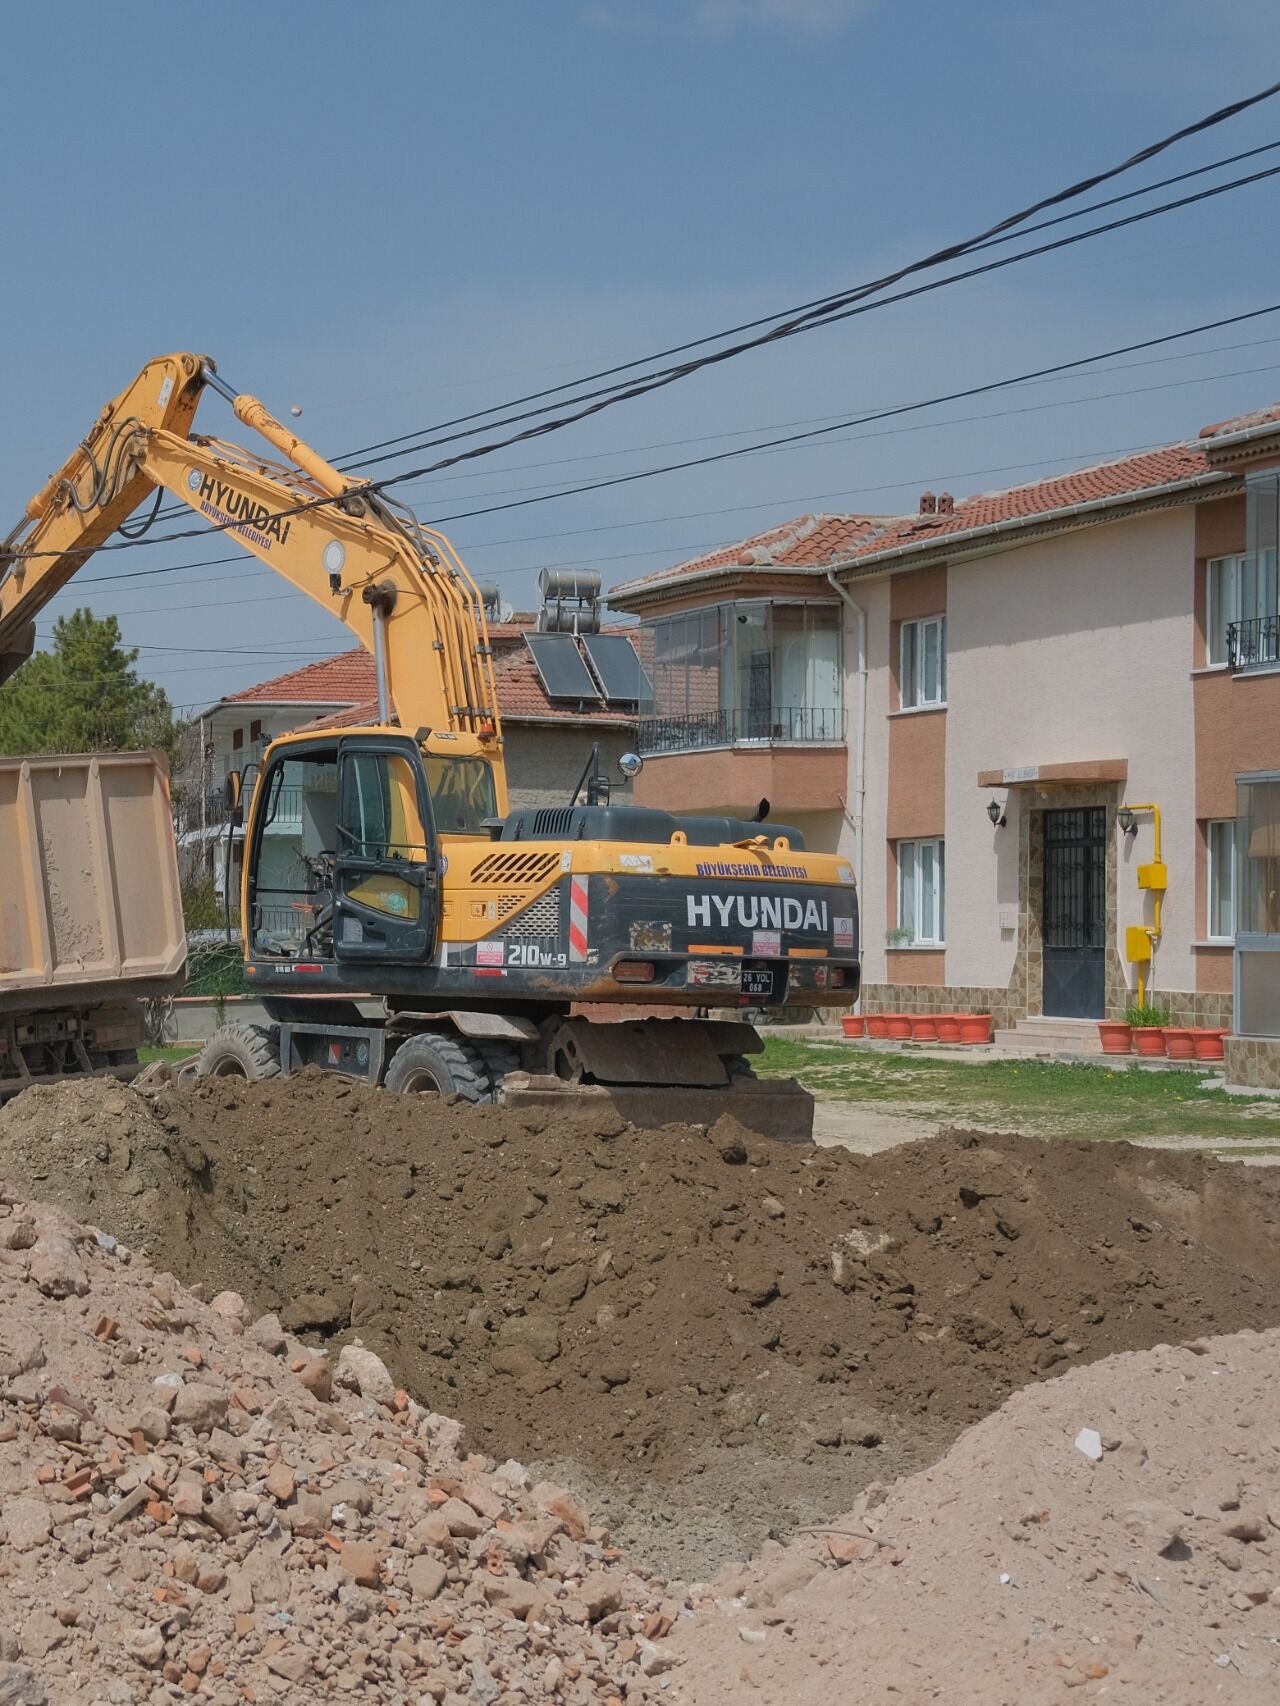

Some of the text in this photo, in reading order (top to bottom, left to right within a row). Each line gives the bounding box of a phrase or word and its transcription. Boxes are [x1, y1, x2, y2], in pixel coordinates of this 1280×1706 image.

[199, 474, 291, 545] HYUNDAI
[696, 861, 808, 879] BÜYÜKŞEHİR BELEDİYESİ
[686, 894, 828, 931] HYUNDAI
[743, 973, 770, 983] 26 YOL
